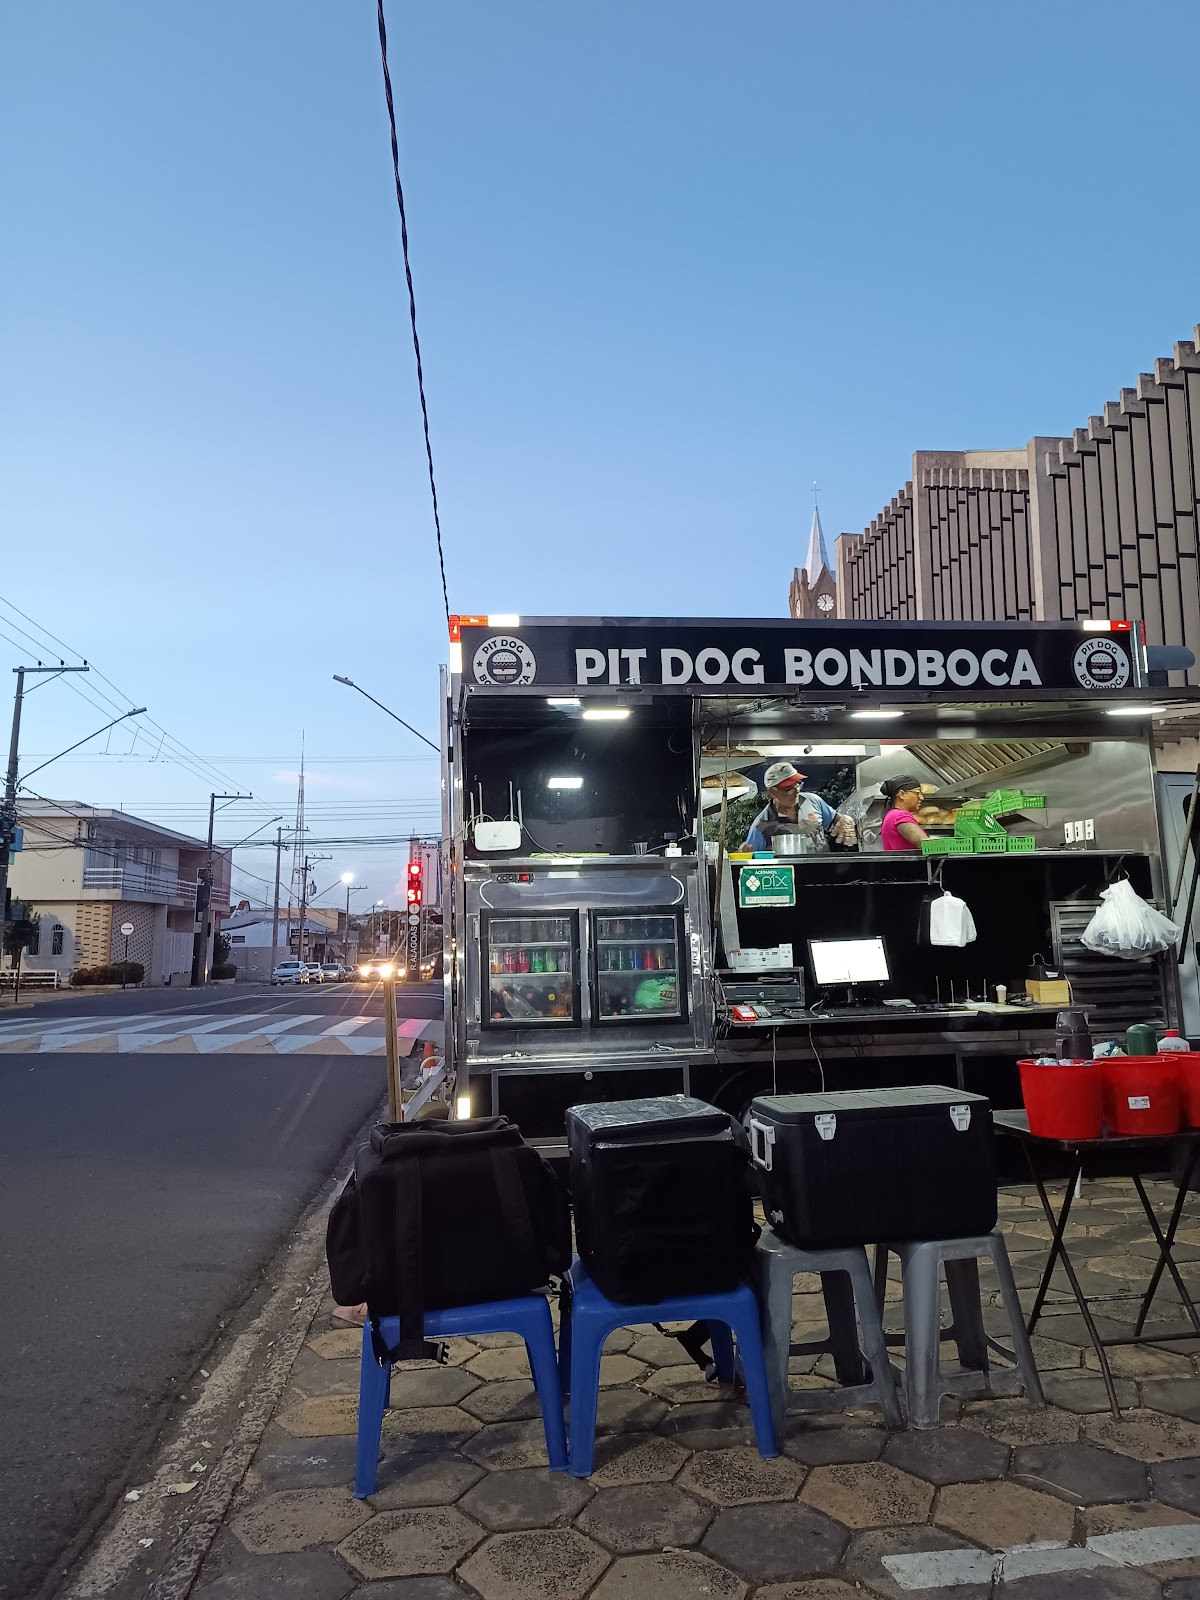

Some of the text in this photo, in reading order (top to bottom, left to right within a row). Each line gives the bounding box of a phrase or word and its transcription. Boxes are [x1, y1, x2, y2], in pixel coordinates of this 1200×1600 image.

[482, 639, 525, 655] PIT DOG
[1081, 641, 1118, 655] PIT DOG
[575, 647, 1043, 687] PIT DOG BONDBOCA
[761, 874, 788, 890] pix
[410, 926, 418, 963] ALAGOAS
